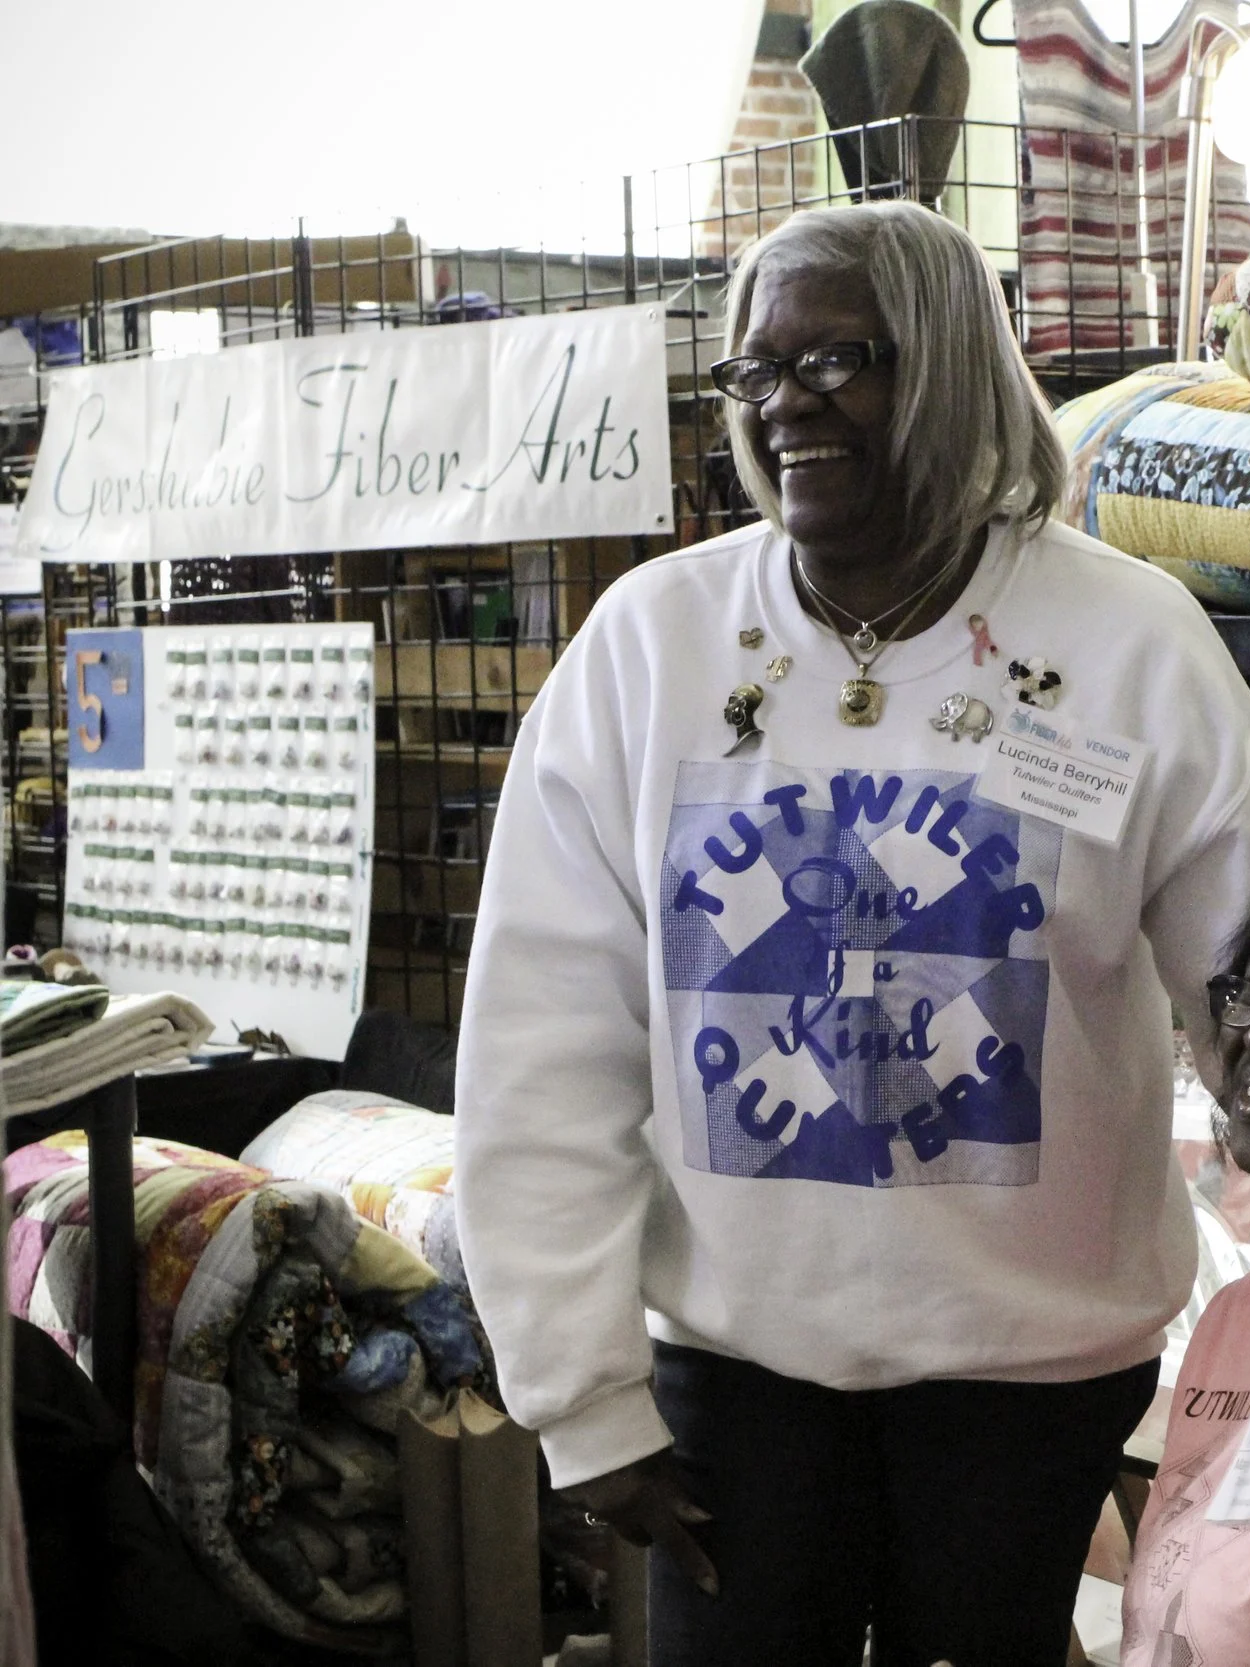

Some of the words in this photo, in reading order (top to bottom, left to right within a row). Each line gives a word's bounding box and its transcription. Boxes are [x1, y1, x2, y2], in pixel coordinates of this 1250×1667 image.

[284, 364, 459, 502] Fiber
[461, 342, 641, 493] Arts
[998, 740, 1059, 773] Lucinda
[1063, 763, 1128, 796] Berryhill
[1086, 738, 1131, 763] VENDOR
[1012, 766, 1056, 790] Tutwiler
[1058, 782, 1102, 806] Quilters
[1020, 791, 1078, 818] Mississippi
[674, 775, 1045, 932] TUTWILER
[782, 856, 930, 920] One
[872, 960, 899, 982] a
[768, 994, 940, 1070] Kind
[693, 1025, 1026, 1180] QUTERS
